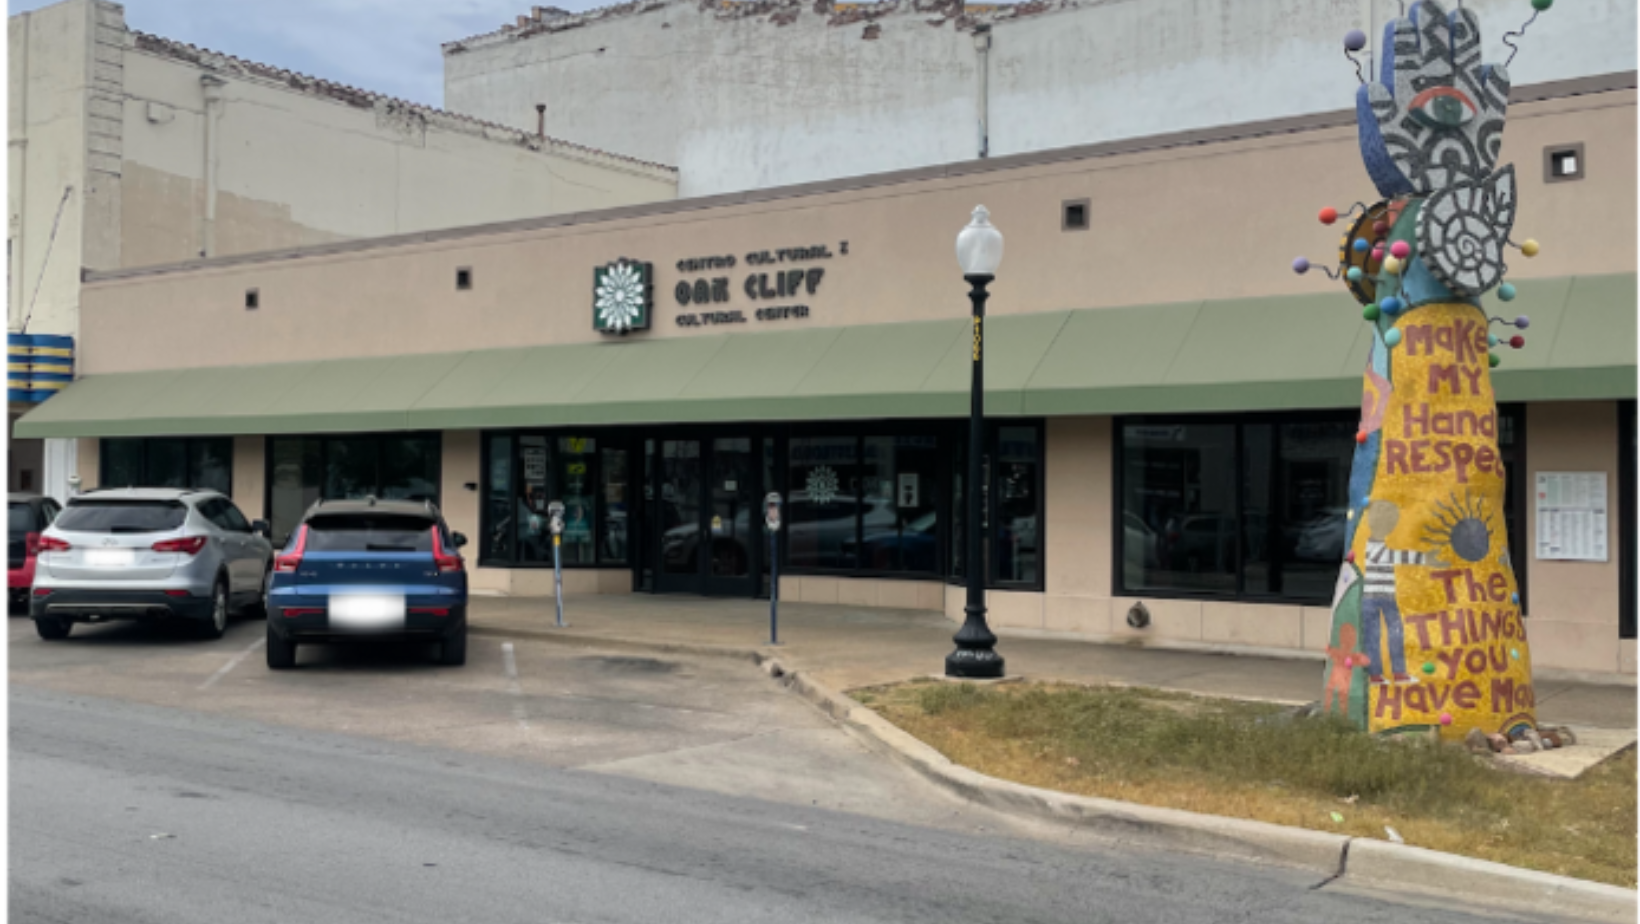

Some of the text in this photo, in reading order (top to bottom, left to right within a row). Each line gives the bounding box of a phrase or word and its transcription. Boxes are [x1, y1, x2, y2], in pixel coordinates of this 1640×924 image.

[675, 267, 826, 306] OAK CLIFF
[1403, 402, 1494, 439] Hand
[1429, 568, 1508, 604] The
[1405, 608, 1527, 651] THINGS
